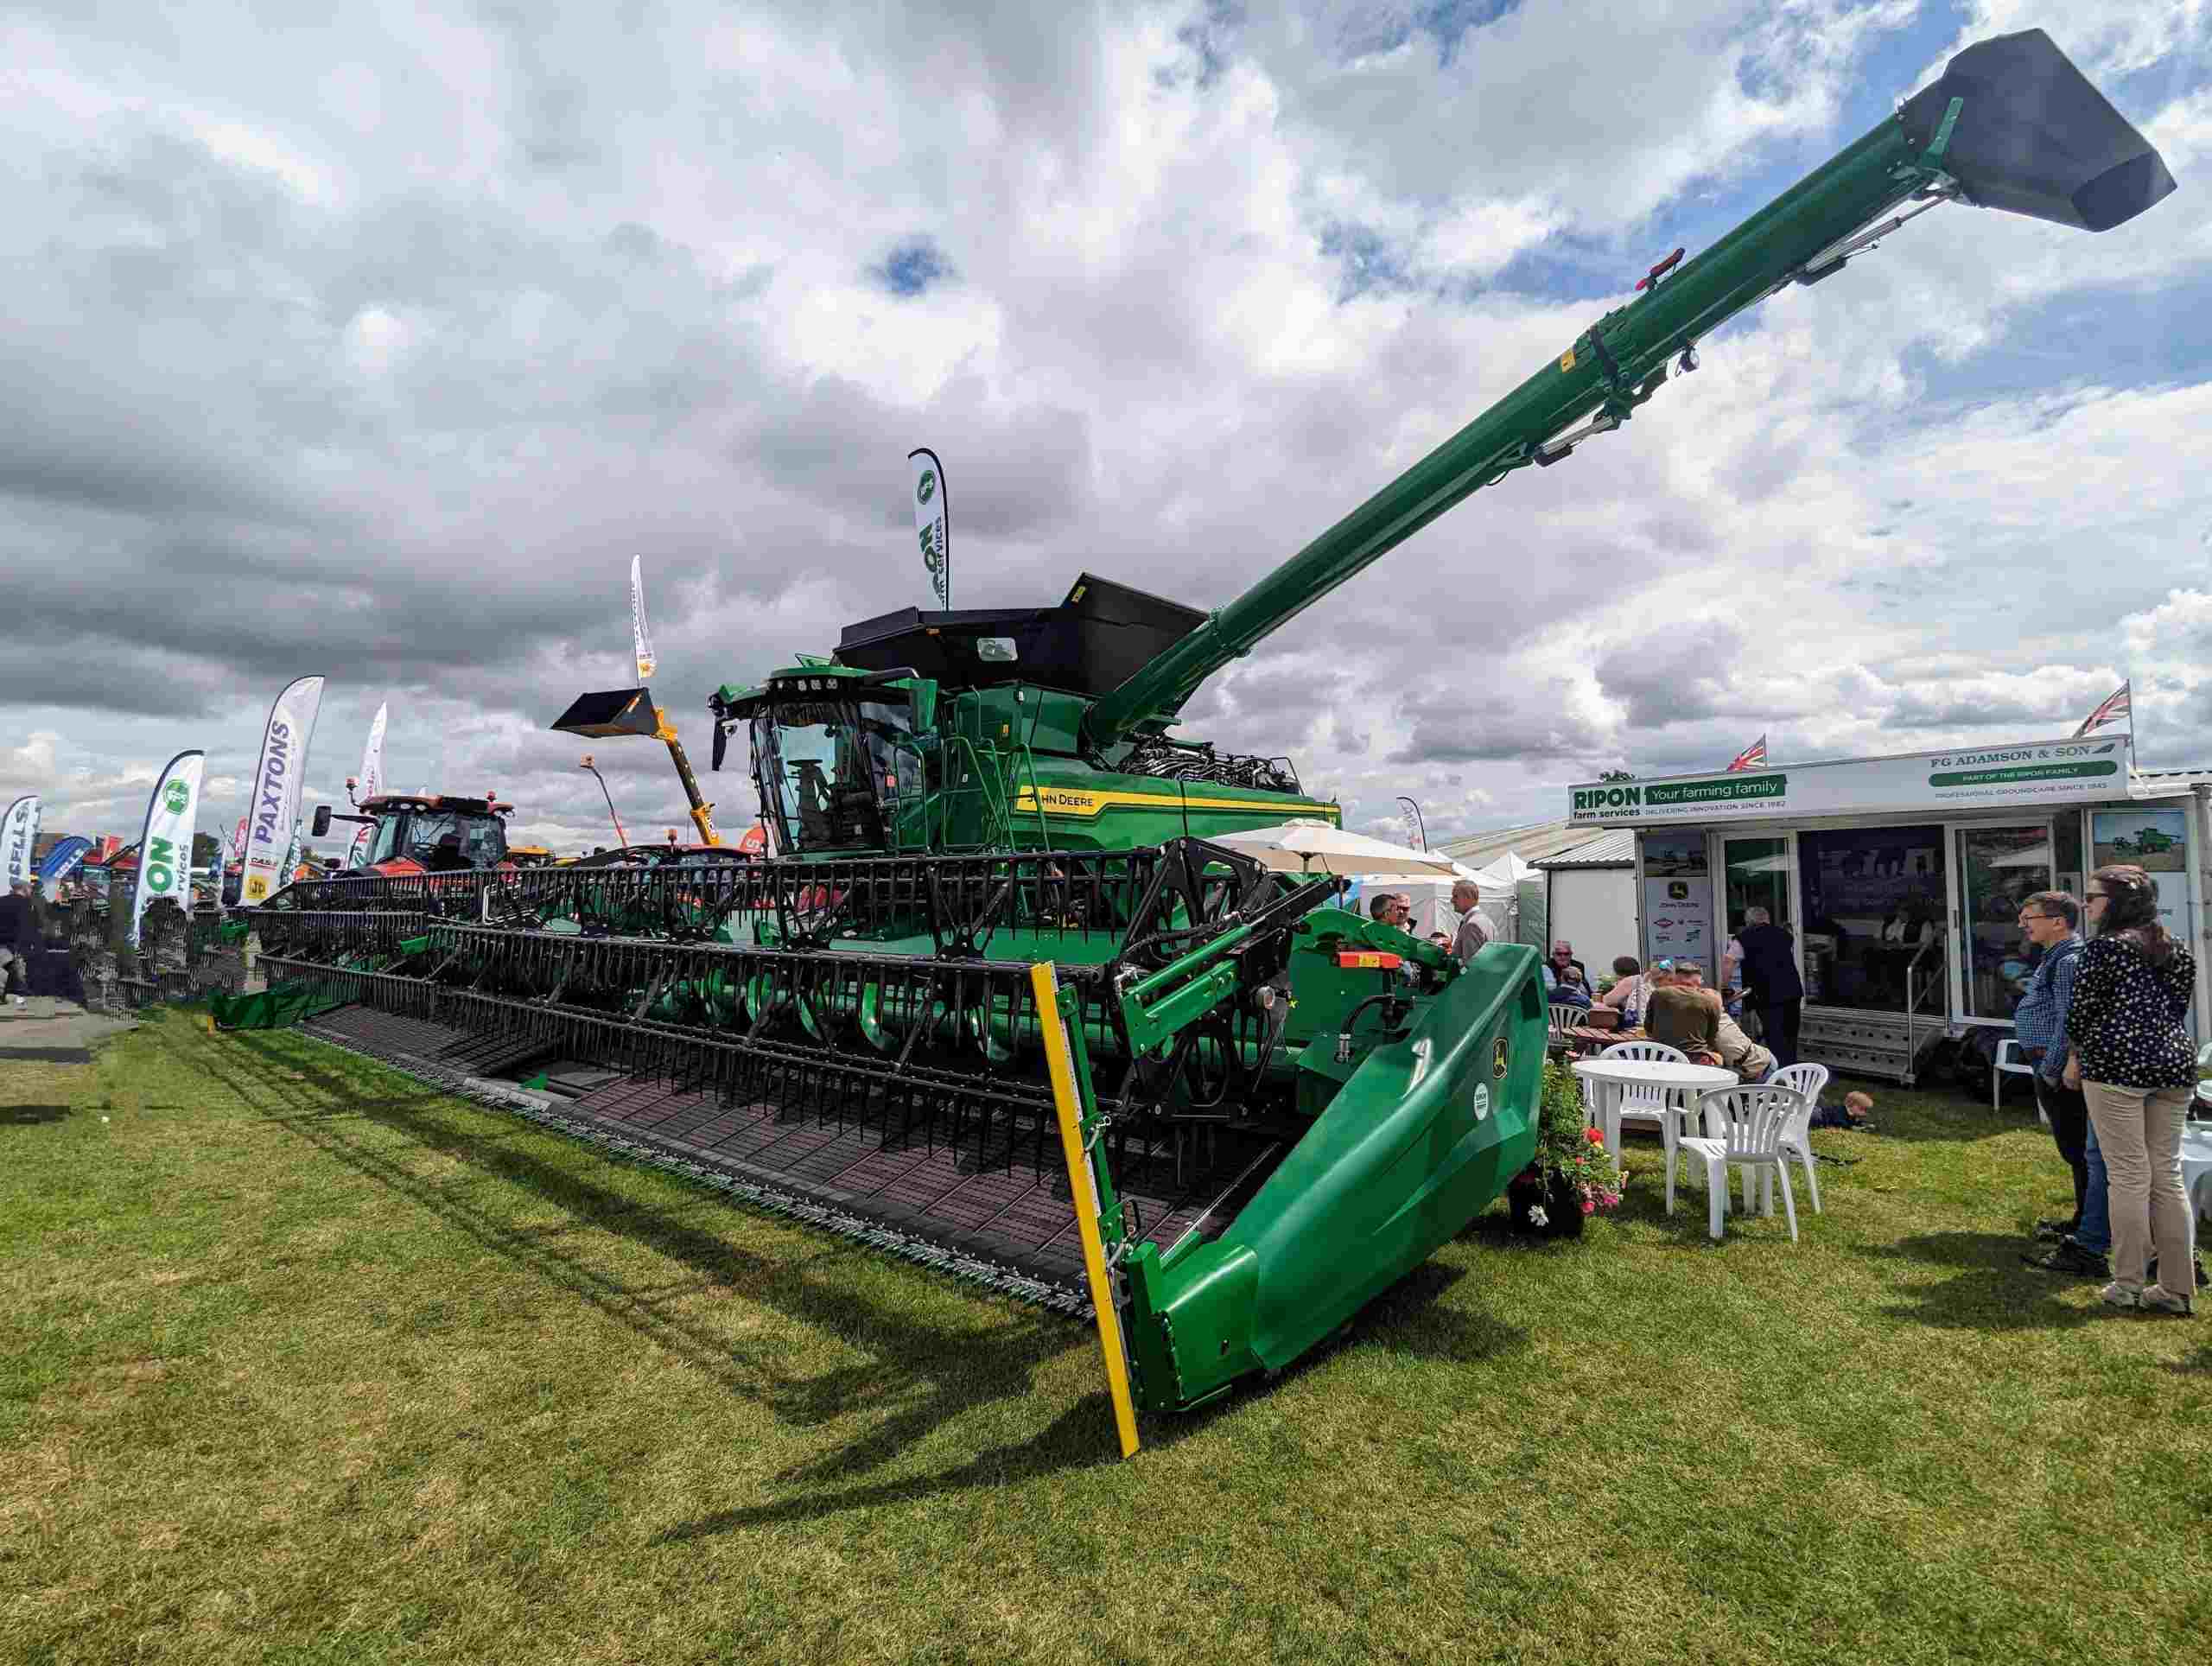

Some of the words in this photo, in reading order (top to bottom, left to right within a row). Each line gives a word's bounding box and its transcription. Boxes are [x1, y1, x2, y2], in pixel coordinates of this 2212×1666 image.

[1956, 750, 2033, 766] ADAMSON
[2037, 749, 2050, 759] &
[2055, 746, 2090, 757] SON
[2045, 766, 2078, 776] FAMILY
[256, 720, 289, 844] PAXTONS
[1028, 793, 1057, 804] JHN
[1573, 787, 1641, 810] RIPON
[1652, 788, 1680, 802] Your
[1682, 785, 1732, 799] farming
[1733, 781, 1777, 797] family
[1573, 809, 1596, 819] farm
[1599, 807, 1641, 818] services
[1740, 801, 1764, 810] SINCE
